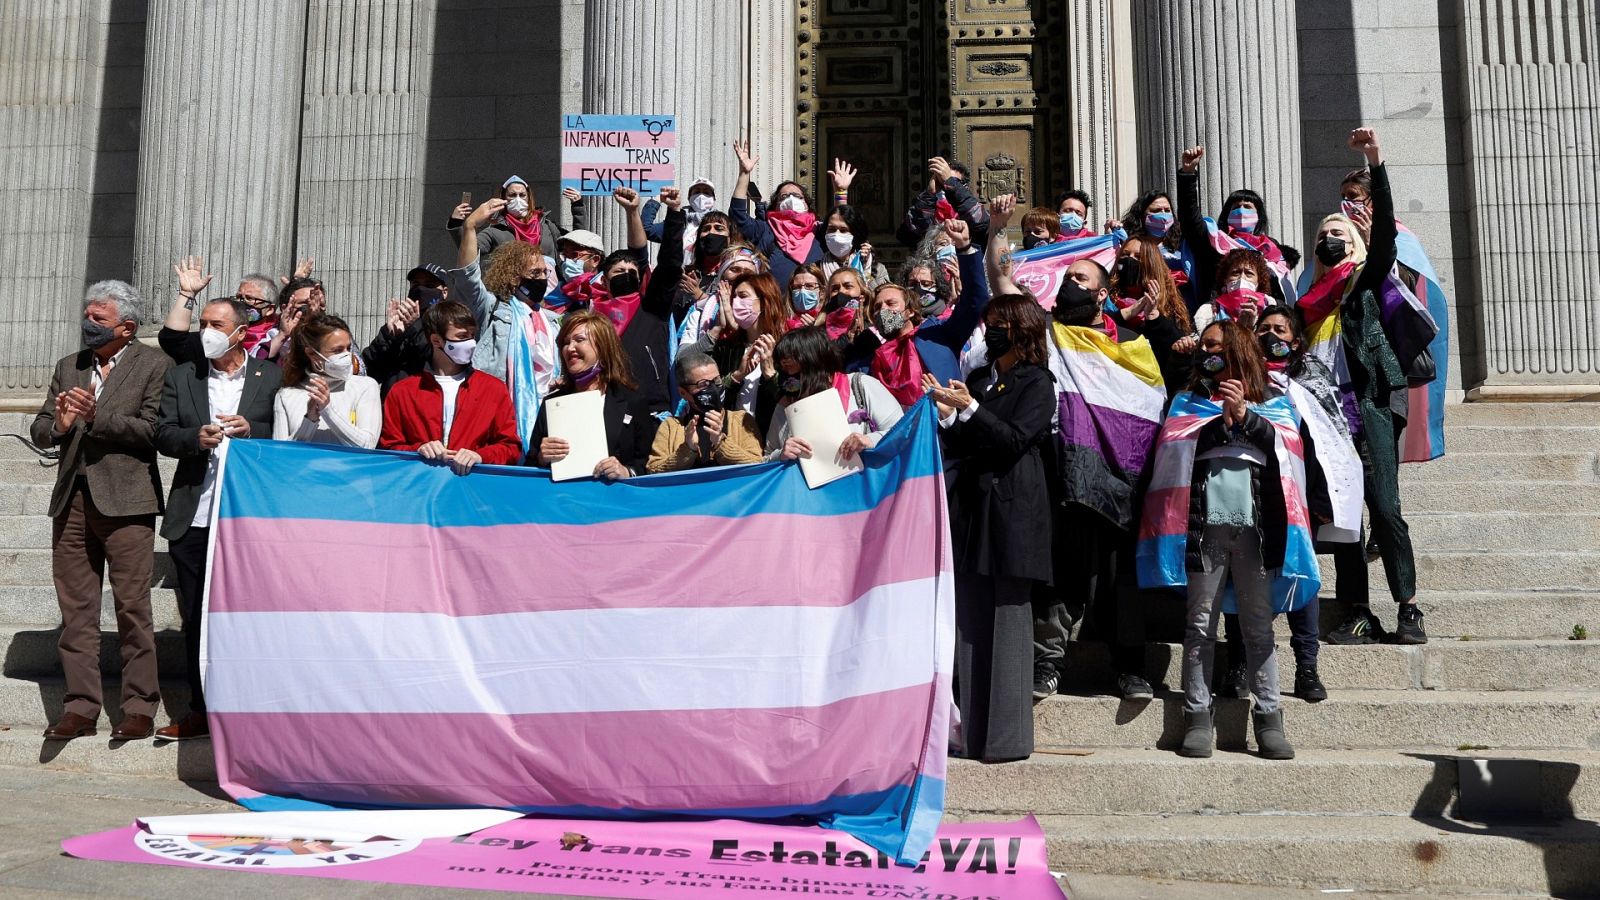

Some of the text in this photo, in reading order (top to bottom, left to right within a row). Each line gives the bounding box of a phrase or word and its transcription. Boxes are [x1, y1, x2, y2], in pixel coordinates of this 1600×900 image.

[567, 115, 585, 128] LA
[564, 131, 632, 148] INFANCIA
[625, 148, 670, 165] TRANS
[580, 168, 652, 192] EXISTE
[450, 833, 540, 850] Ley
[710, 839, 889, 869] Estatal
[448, 865, 487, 873] no
[496, 866, 630, 883] binarias,
[640, 878, 656, 886] y
[664, 880, 712, 888] sus
[724, 882, 854, 895] Familias
[531, 861, 665, 876] Personas
[781, 876, 905, 890] binarias
